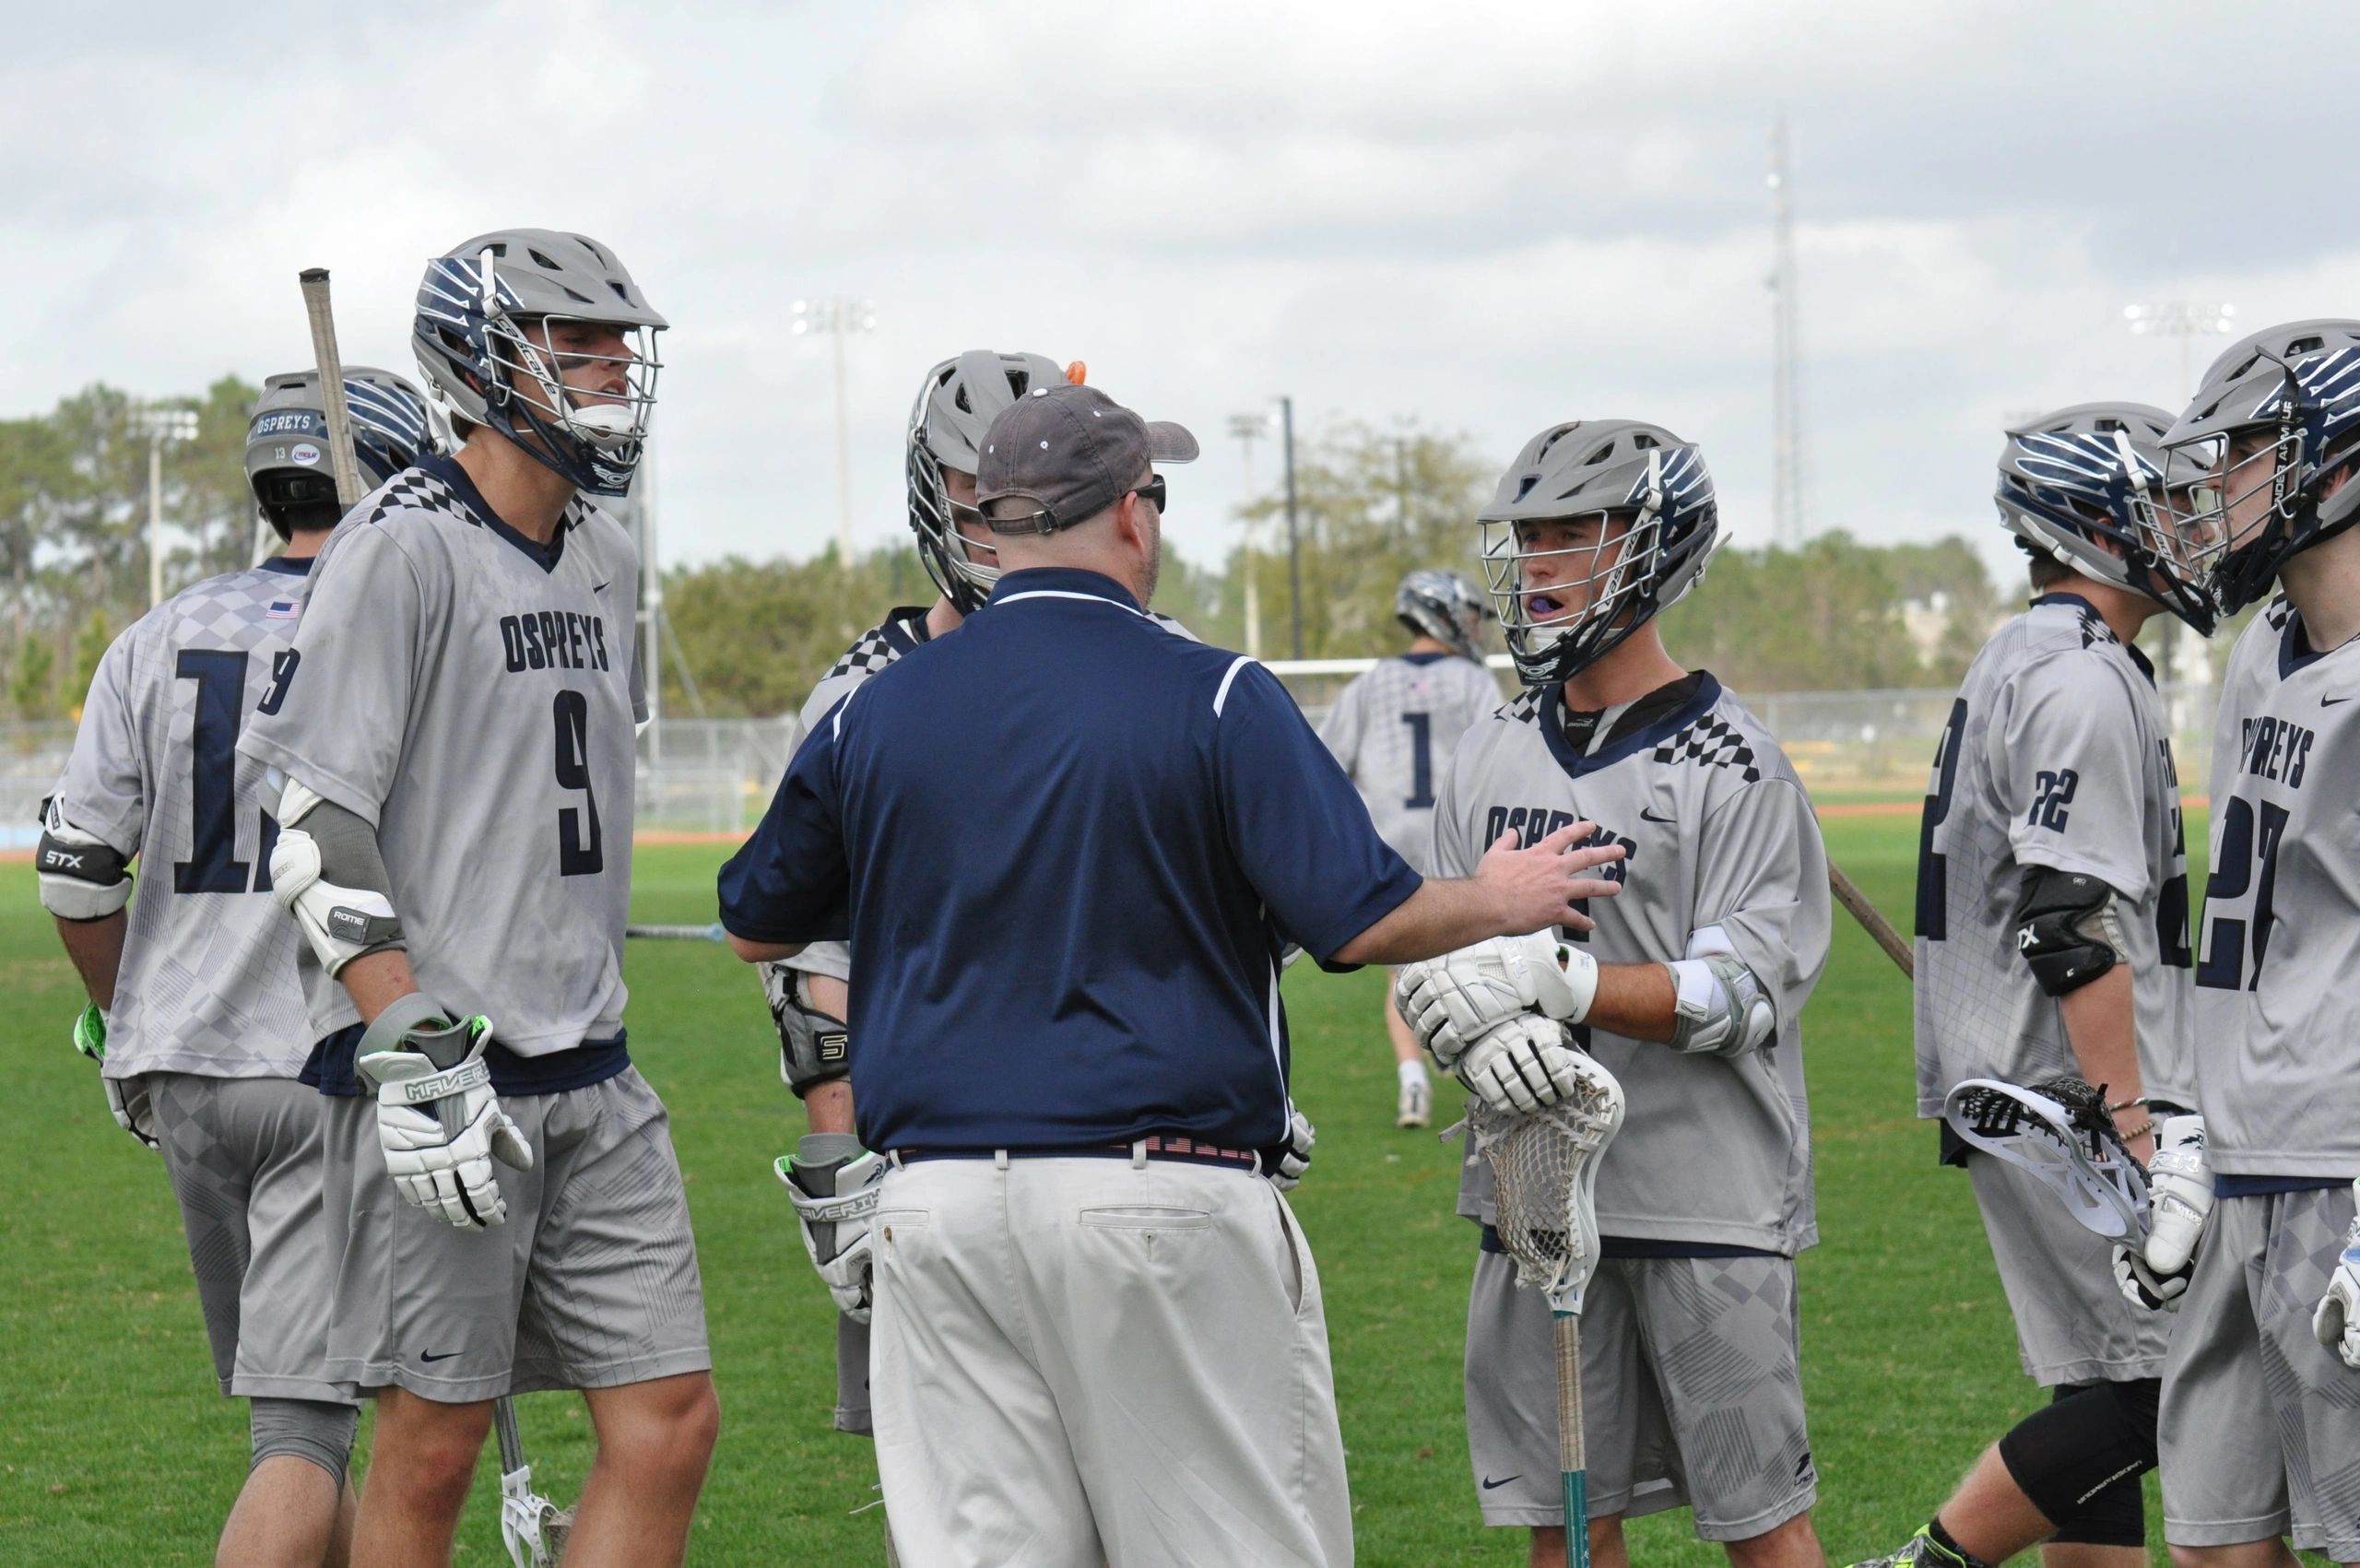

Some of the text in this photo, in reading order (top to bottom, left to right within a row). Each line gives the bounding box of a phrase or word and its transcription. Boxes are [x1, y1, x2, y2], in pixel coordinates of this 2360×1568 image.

[257, 415, 311, 434] OSPREYS
[275, 447, 287, 459] 13
[2274, 401, 2293, 504] NDER ARMUR
[500, 611, 608, 673] OSPREYS
[553, 690, 603, 876] 9
[1402, 712, 1438, 809] 1
[2028, 769, 2079, 833] 22
[45, 850, 84, 868] STX
[1484, 806, 1637, 890] OSPYS
[334, 911, 365, 925] ROME
[2196, 796, 2290, 992] 27
